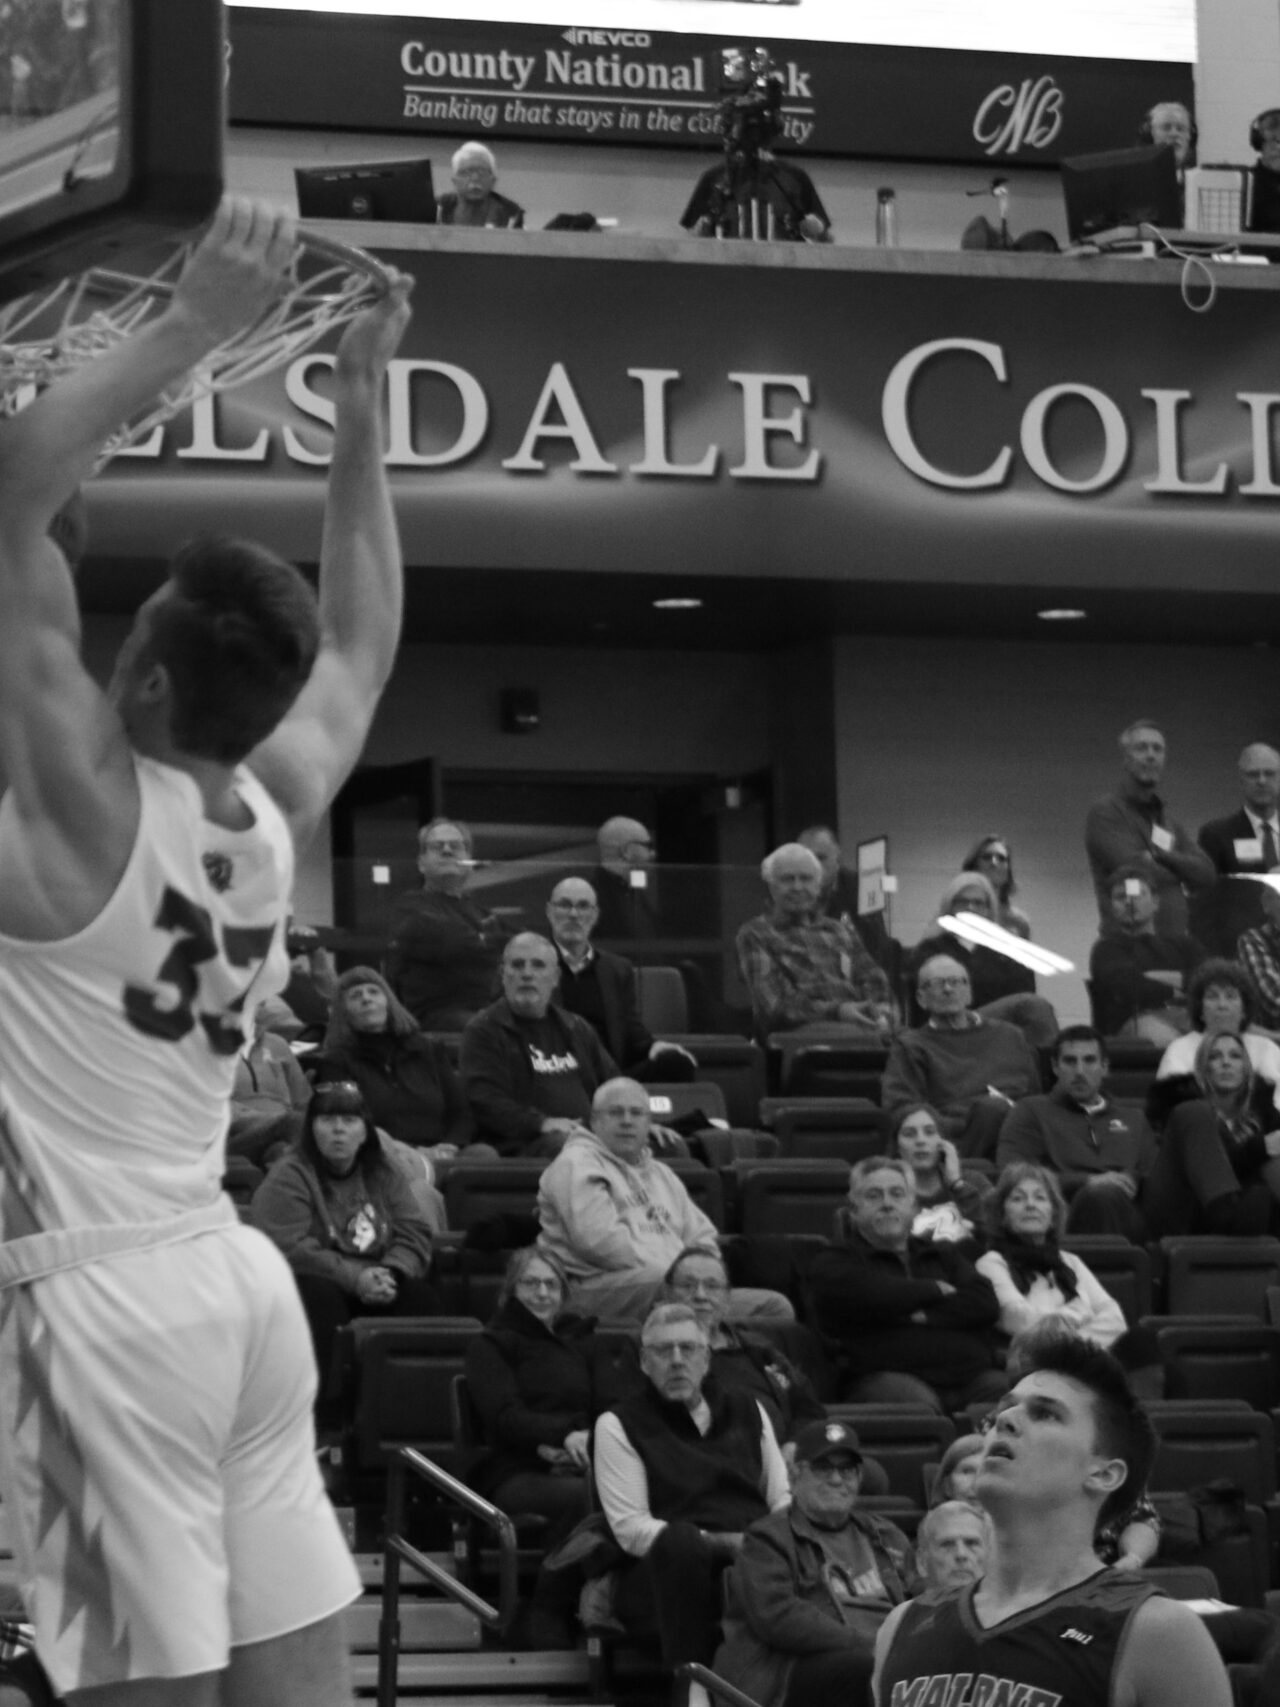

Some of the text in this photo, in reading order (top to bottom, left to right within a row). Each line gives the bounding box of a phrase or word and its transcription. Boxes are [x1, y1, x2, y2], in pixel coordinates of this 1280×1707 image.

[577, 28, 652, 48] NEVCO
[400, 41, 536, 91] County
[545, 49, 705, 92] National
[403, 94, 499, 128] Banking
[504, 100, 552, 125] that
[556, 103, 614, 133] stays
[619, 107, 641, 131] in
[646, 107, 683, 132] the
[972, 75, 1064, 156] CNB
